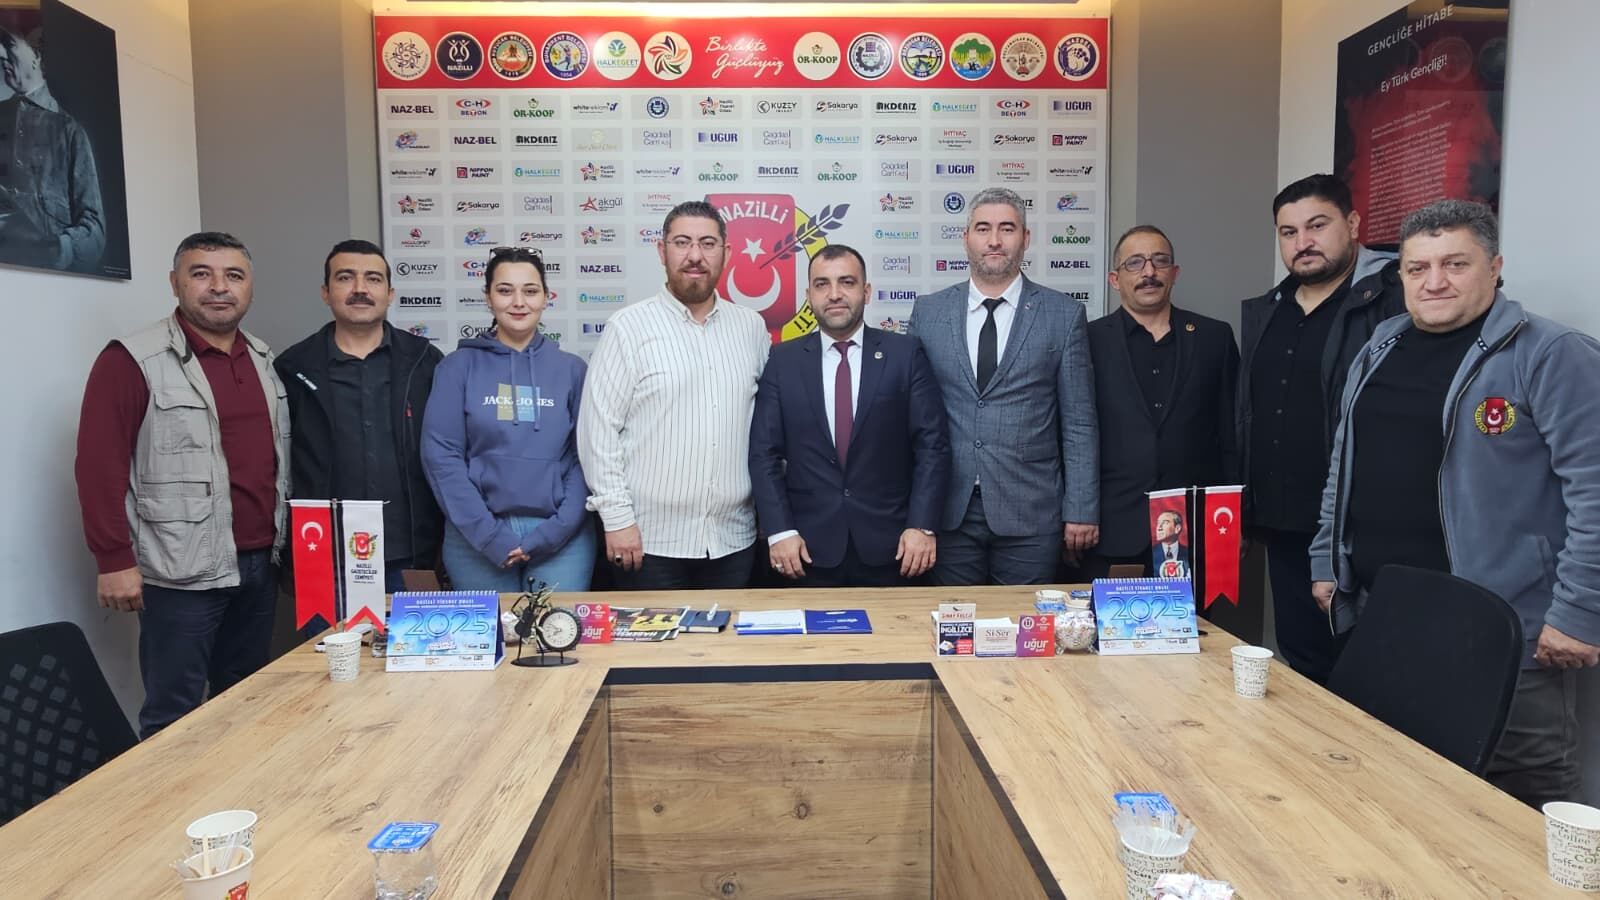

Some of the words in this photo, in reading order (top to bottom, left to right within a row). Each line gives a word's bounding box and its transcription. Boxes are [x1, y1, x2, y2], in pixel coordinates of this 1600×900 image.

[1367, 25, 1413, 56] GENÇLİĞE
[1415, 4, 1454, 33] HİTABE
[1381, 80, 1391, 93] Ey
[1392, 72, 1409, 86] Türk
[1410, 54, 1448, 80] Gençliği!
[391, 105, 434, 114] NAZ-BEL
[827, 101, 858, 110] Sakarya
[886, 134, 917, 144] Sakarya
[1005, 135, 1035, 144] Sakarya
[468, 201, 500, 209] Sakarya
[598, 197, 622, 208] akgül
[1106, 594, 1189, 622] 2025
[404, 608, 490, 638] 2025
[1024, 638, 1048, 650] uğur
